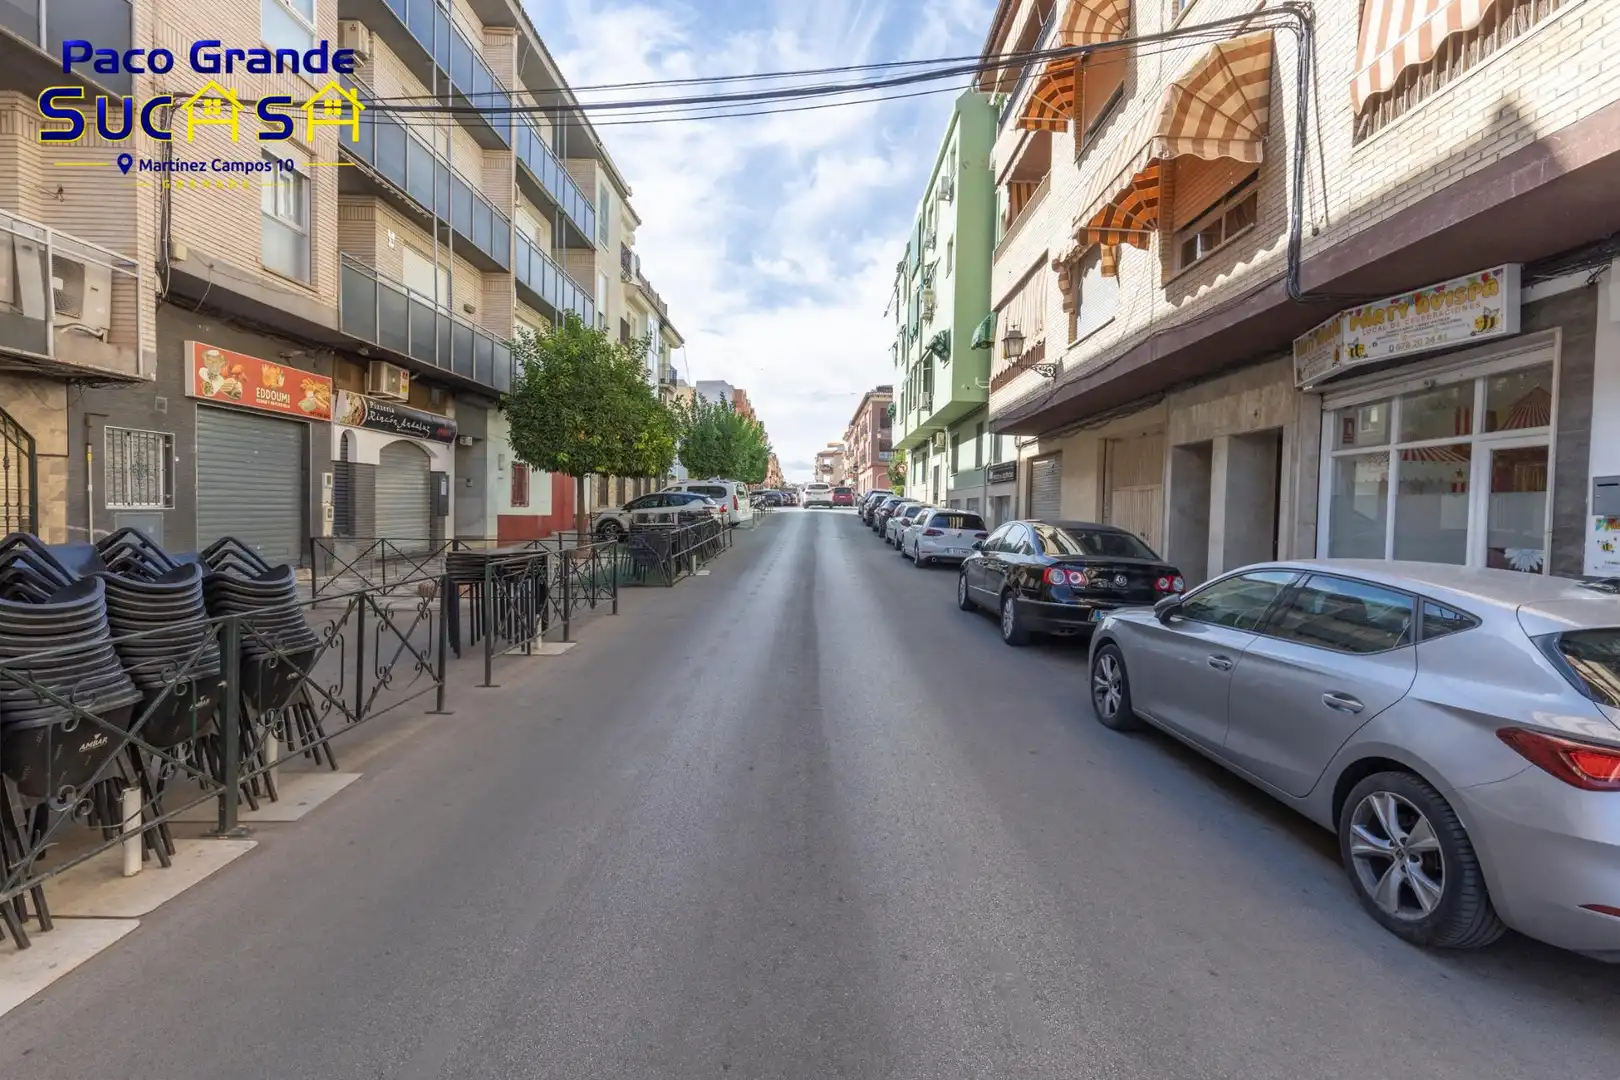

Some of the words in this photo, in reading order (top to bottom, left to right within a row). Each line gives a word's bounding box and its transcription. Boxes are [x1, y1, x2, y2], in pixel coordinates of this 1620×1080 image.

[1350, 303, 1409, 331] PARTY
[256, 387, 290, 404] EDDOUMI
[79, 736, 108, 752] AMBAR
